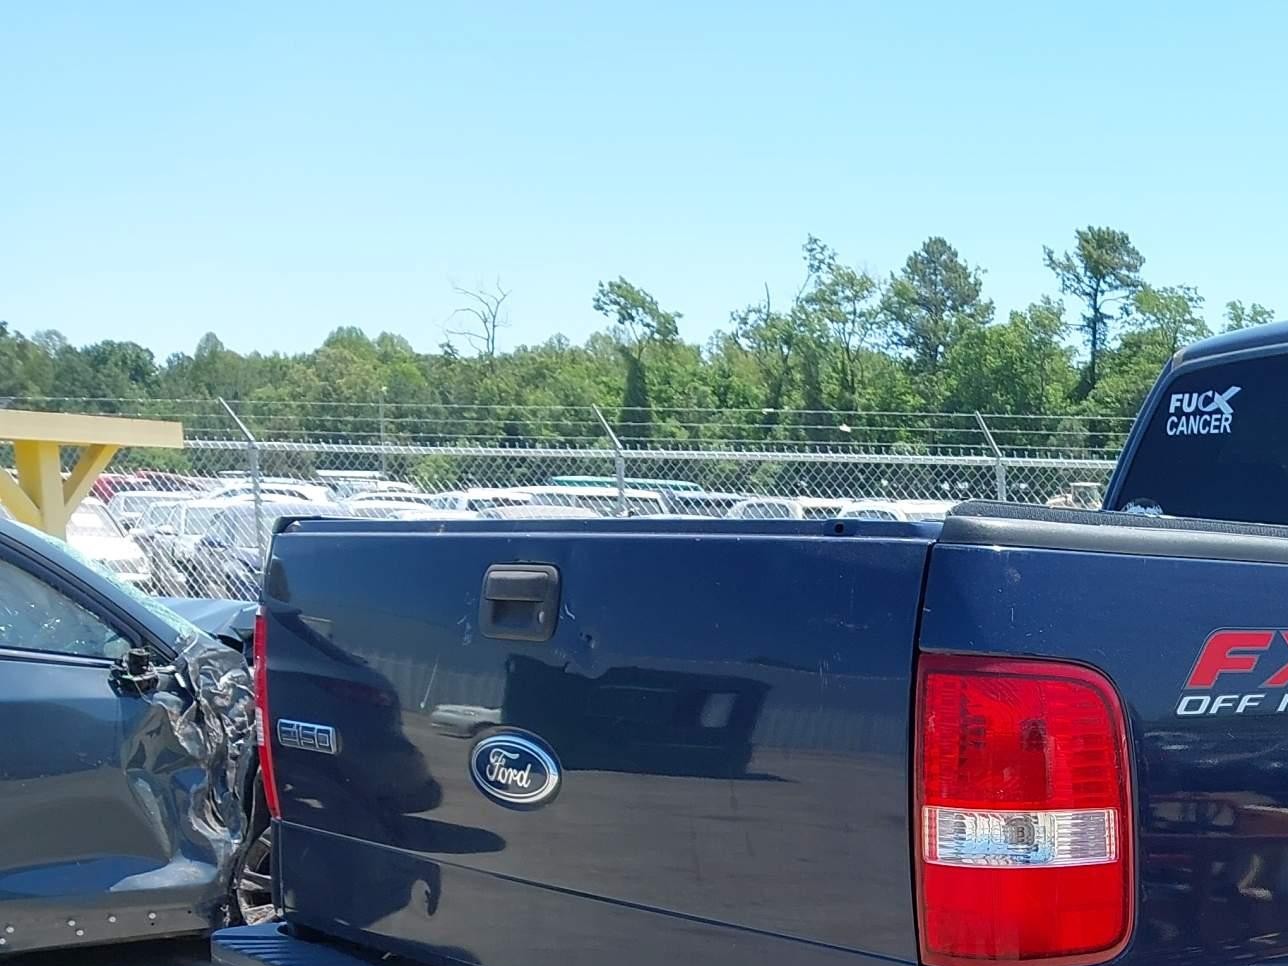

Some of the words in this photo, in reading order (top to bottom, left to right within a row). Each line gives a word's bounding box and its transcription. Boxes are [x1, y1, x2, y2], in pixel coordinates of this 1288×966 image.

[1166, 413, 1233, 436] CANCER
[1176, 694, 1266, 716] OFF
[486, 748, 532, 788] Ford
